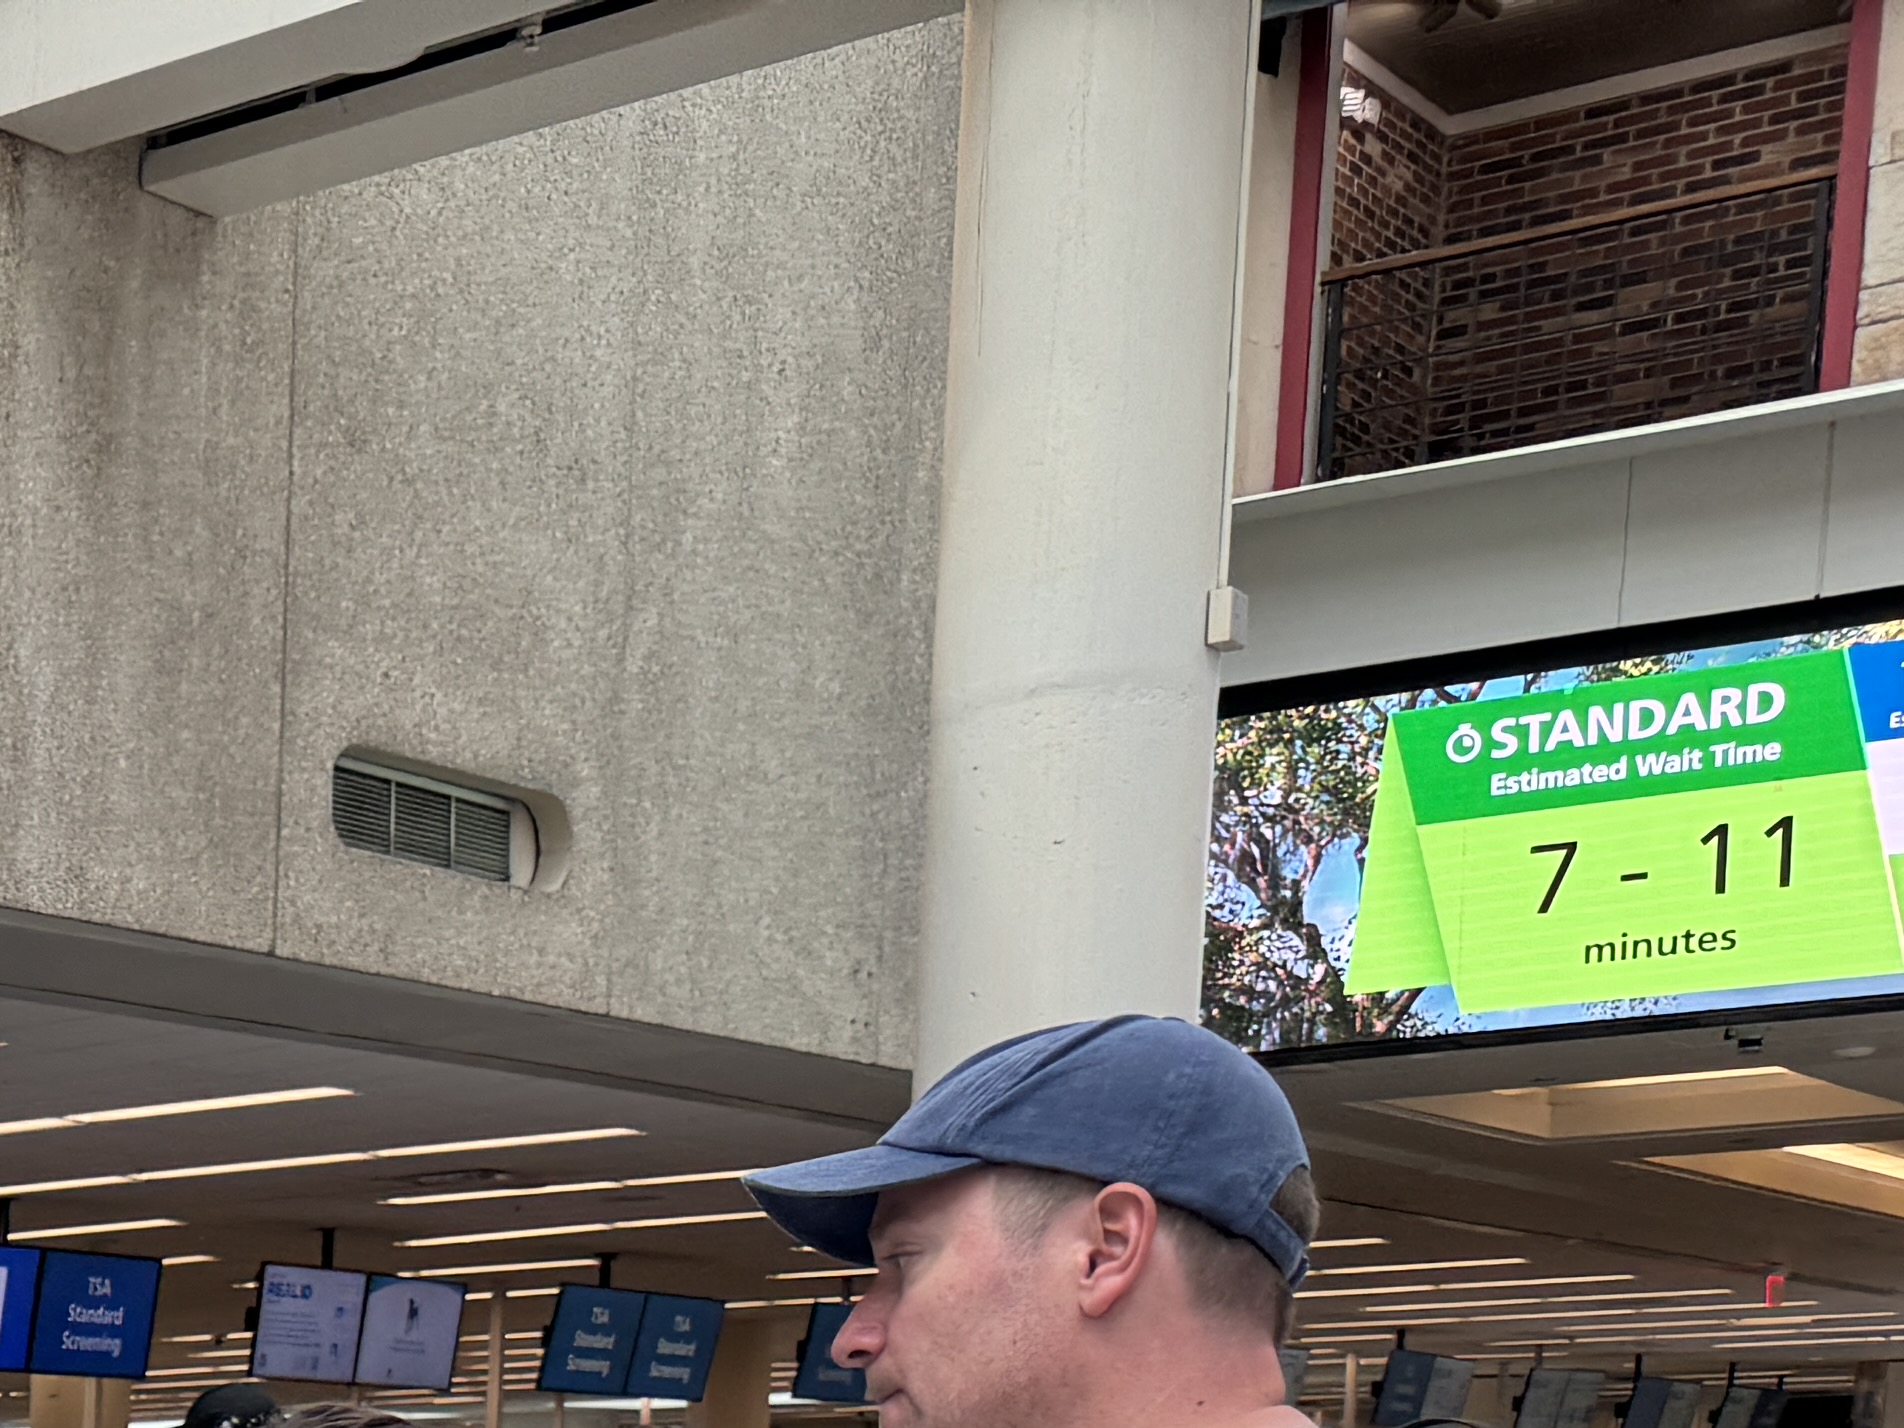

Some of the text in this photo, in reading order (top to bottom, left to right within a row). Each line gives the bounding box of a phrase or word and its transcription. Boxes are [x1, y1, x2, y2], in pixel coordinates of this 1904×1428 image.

[1489, 682, 1785, 759] STANDARD
[1490, 739, 1782, 797] Estimated Wait Time
[1531, 840, 1578, 915] 7
[1700, 815, 1794, 895] 11
[1584, 928, 1737, 965] minutes
[67, 1303, 124, 1326] Standard
[61, 1330, 123, 1357] Screening
